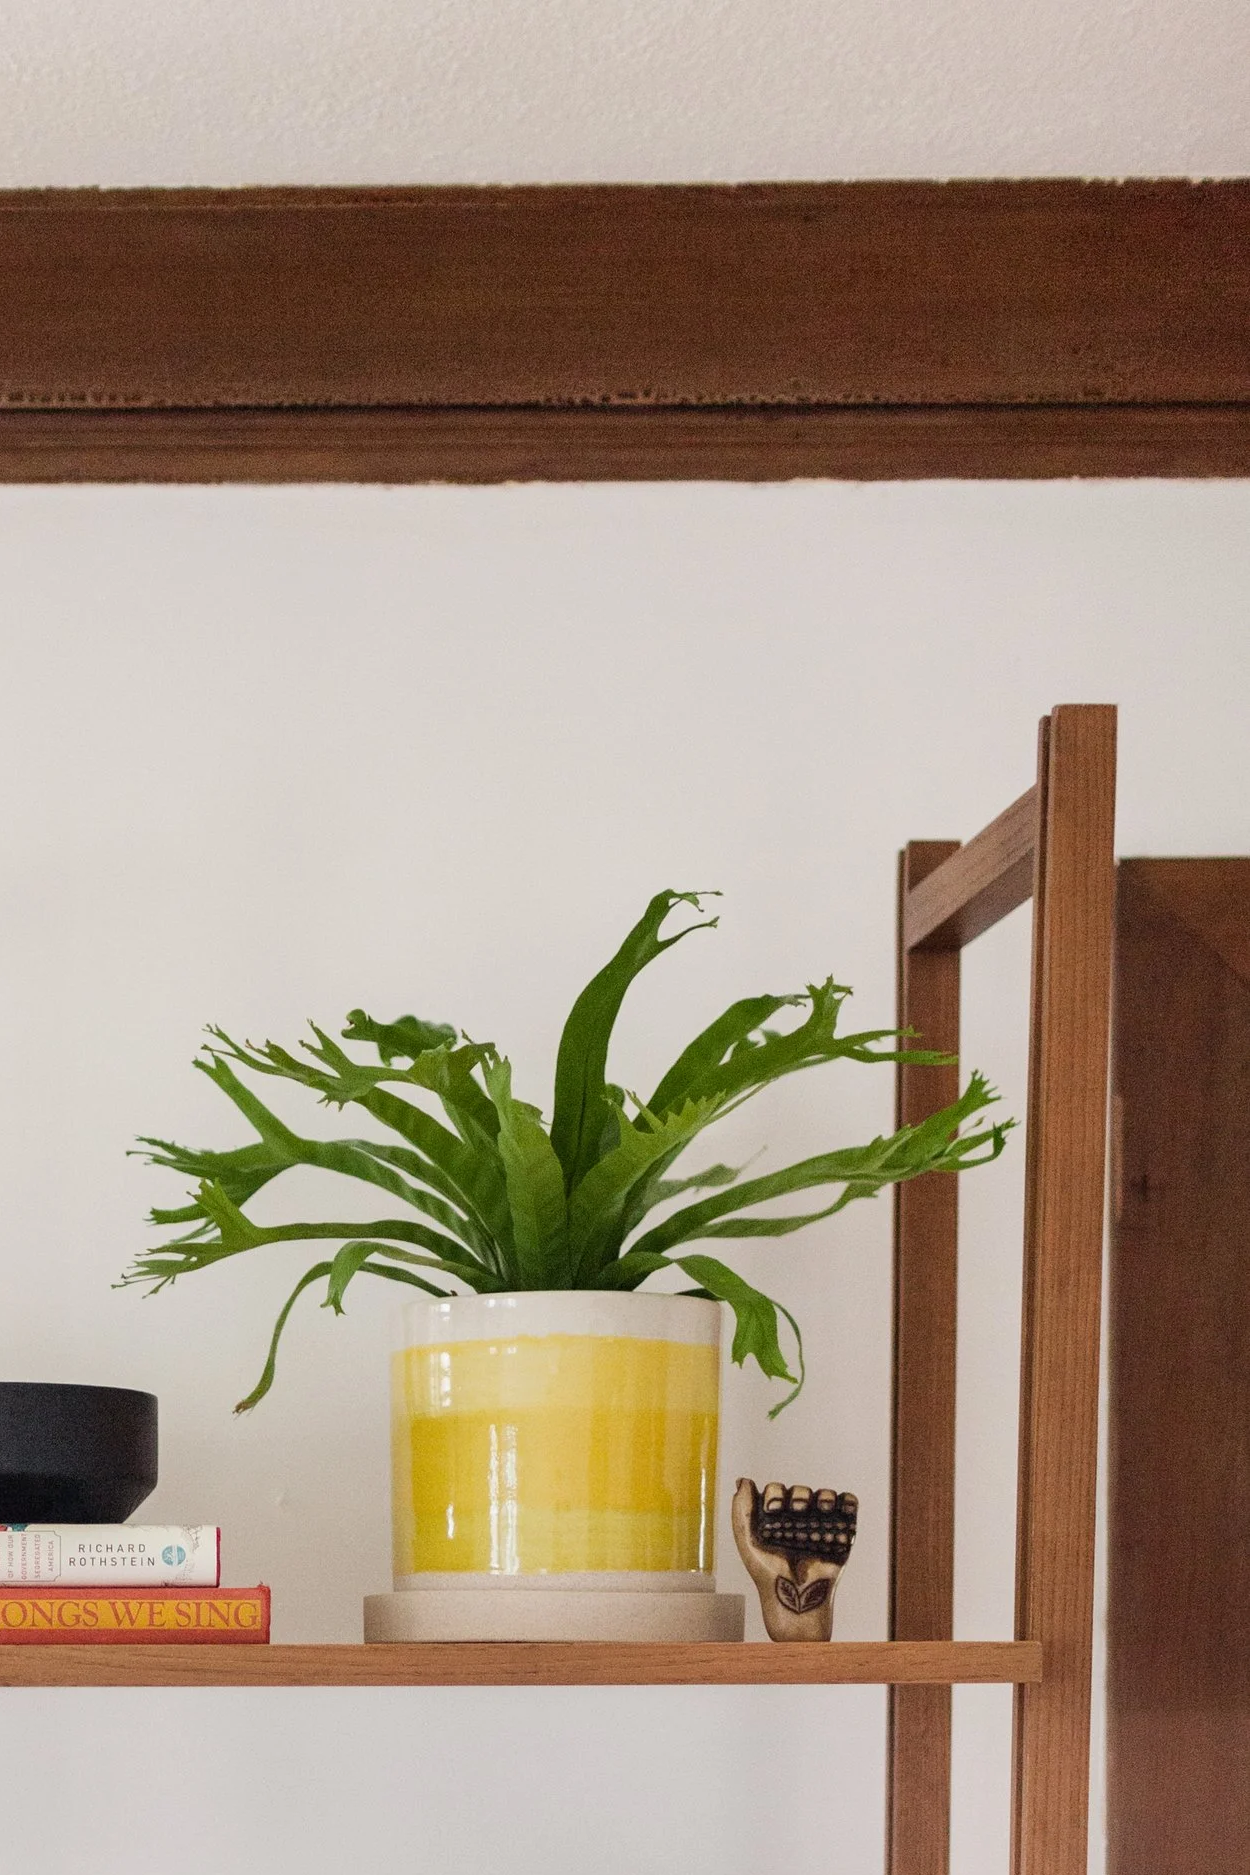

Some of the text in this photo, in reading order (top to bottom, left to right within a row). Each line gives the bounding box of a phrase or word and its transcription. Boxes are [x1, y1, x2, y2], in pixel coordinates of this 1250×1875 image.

[20, 1533, 28, 1580] GOVERNMENT
[77, 1543, 146, 1553] RICHARD
[68, 1556, 156, 1567] ROTHSTEIN
[108, 1601, 167, 1628] WE
[174, 1601, 259, 1628] SING
